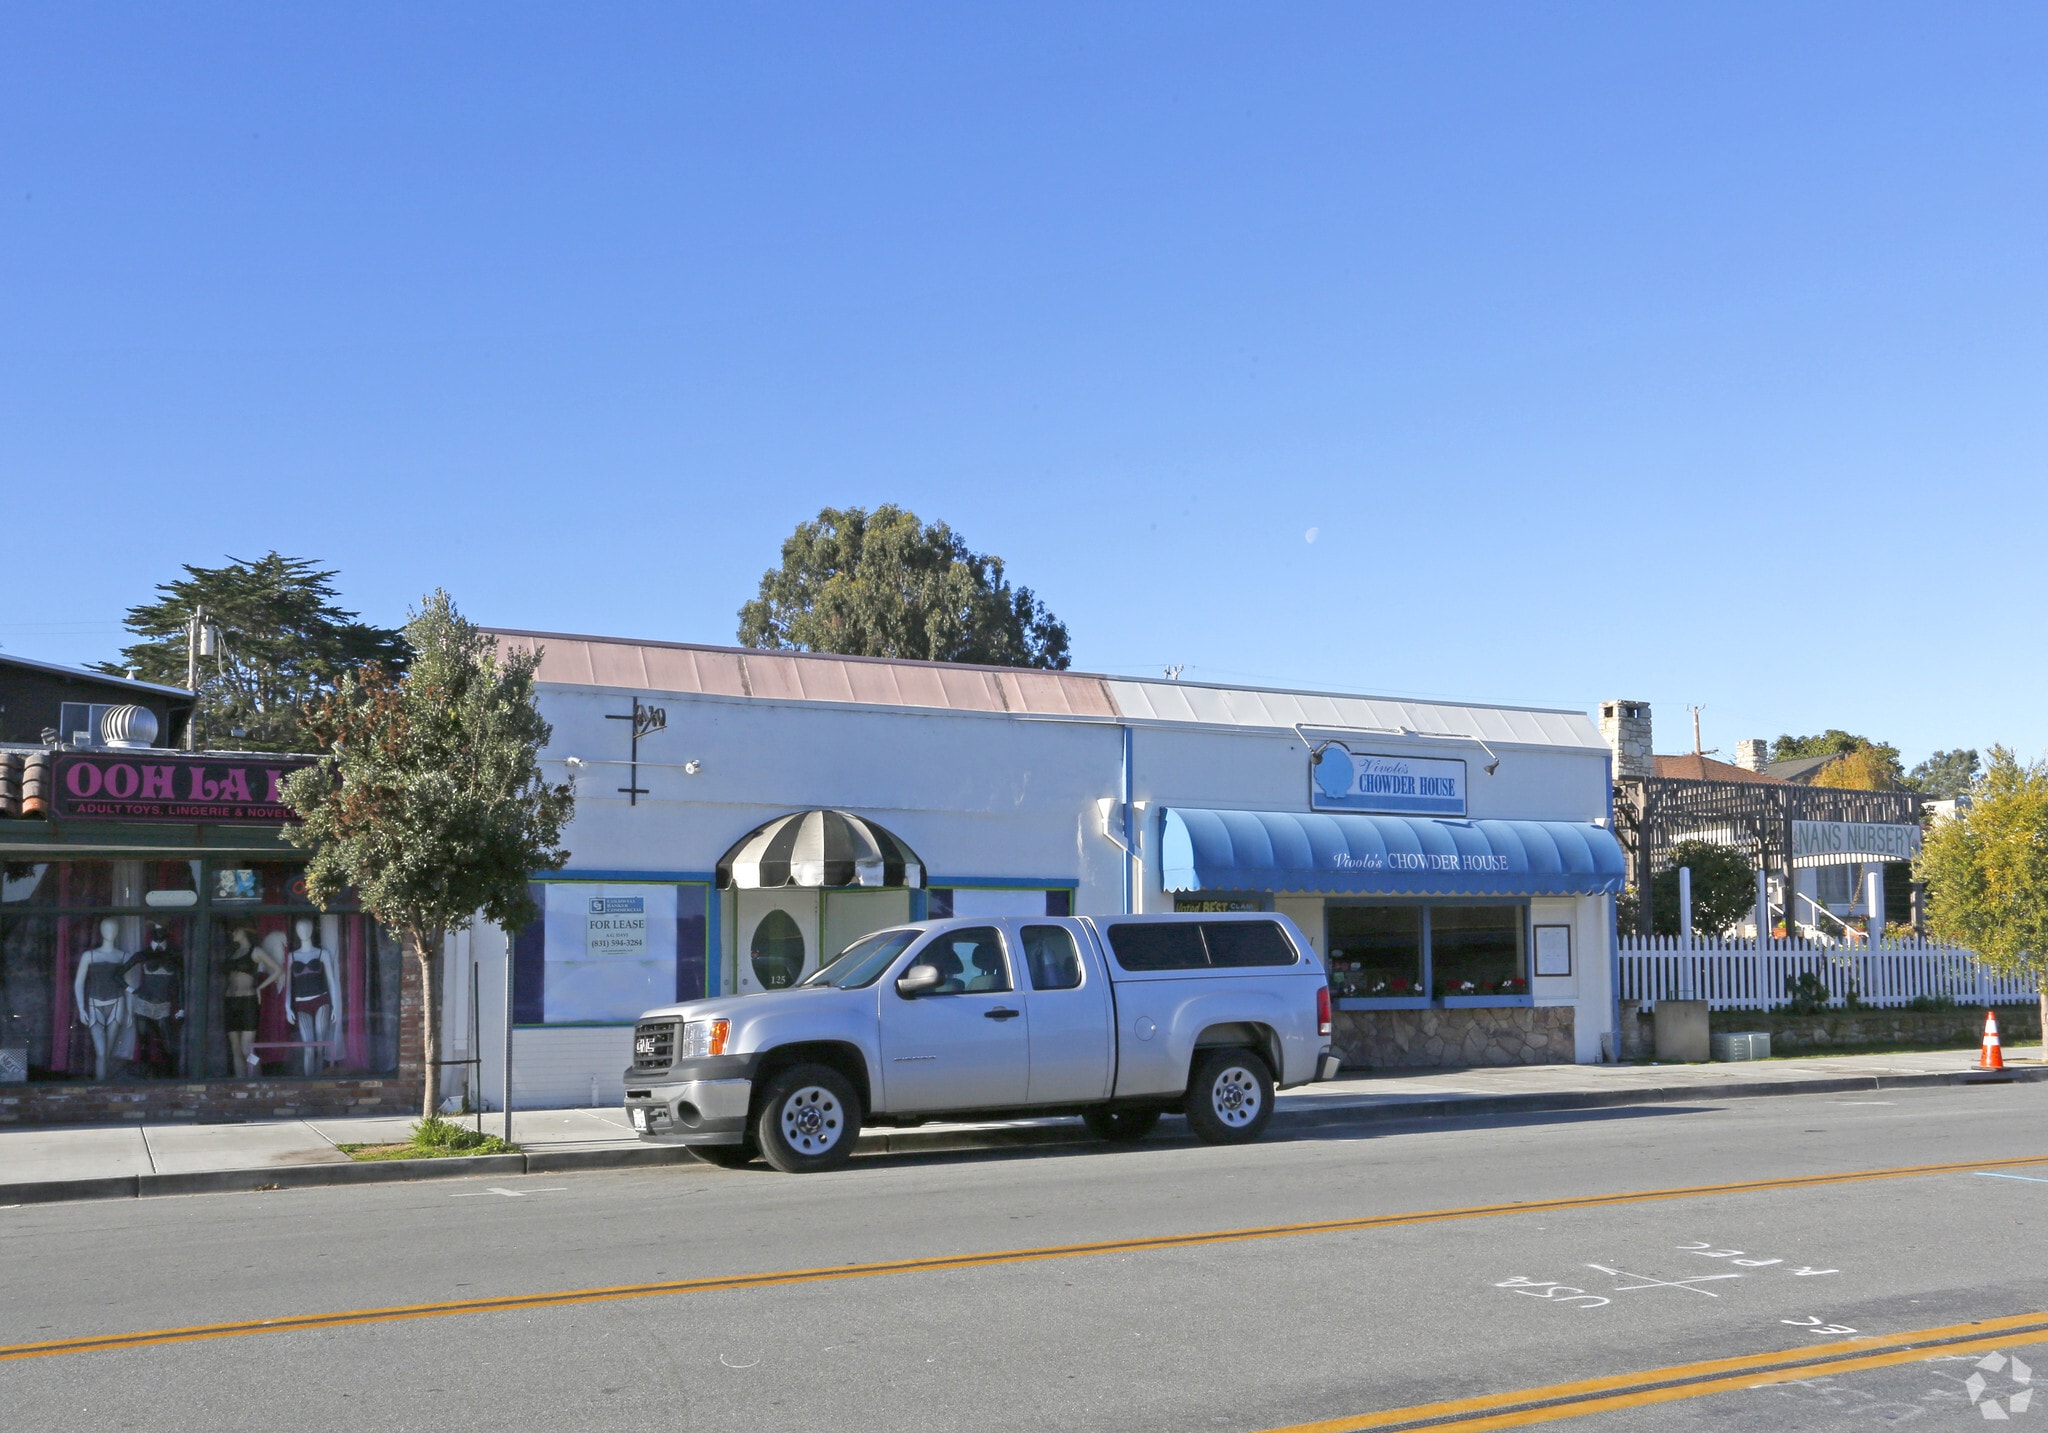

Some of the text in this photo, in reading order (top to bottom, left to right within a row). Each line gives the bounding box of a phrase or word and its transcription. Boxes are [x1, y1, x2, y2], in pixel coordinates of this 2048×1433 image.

[1359, 759, 1409, 774] Vivolo's
[66, 762, 177, 799] OOH
[188, 766, 253, 802] LA
[1359, 773, 1455, 797] CHOWDER HOUSE
[77, 803, 122, 815] ADULT
[126, 804, 164, 816] TOYS,
[168, 805, 230, 817] LINGERIE
[235, 806, 243, 817] &
[1798, 823, 1914, 857] NAN'S NURSERY
[1333, 853, 1509, 871] Vivolo's CHOWDER HOUSE
[1176, 901, 1201, 912] Voted
[1202, 901, 1228, 912] BEST
[590, 919, 645, 929] FOR LEASE
[591, 939, 642, 949] (831) 594-3284
[771, 975, 786, 985] 125
